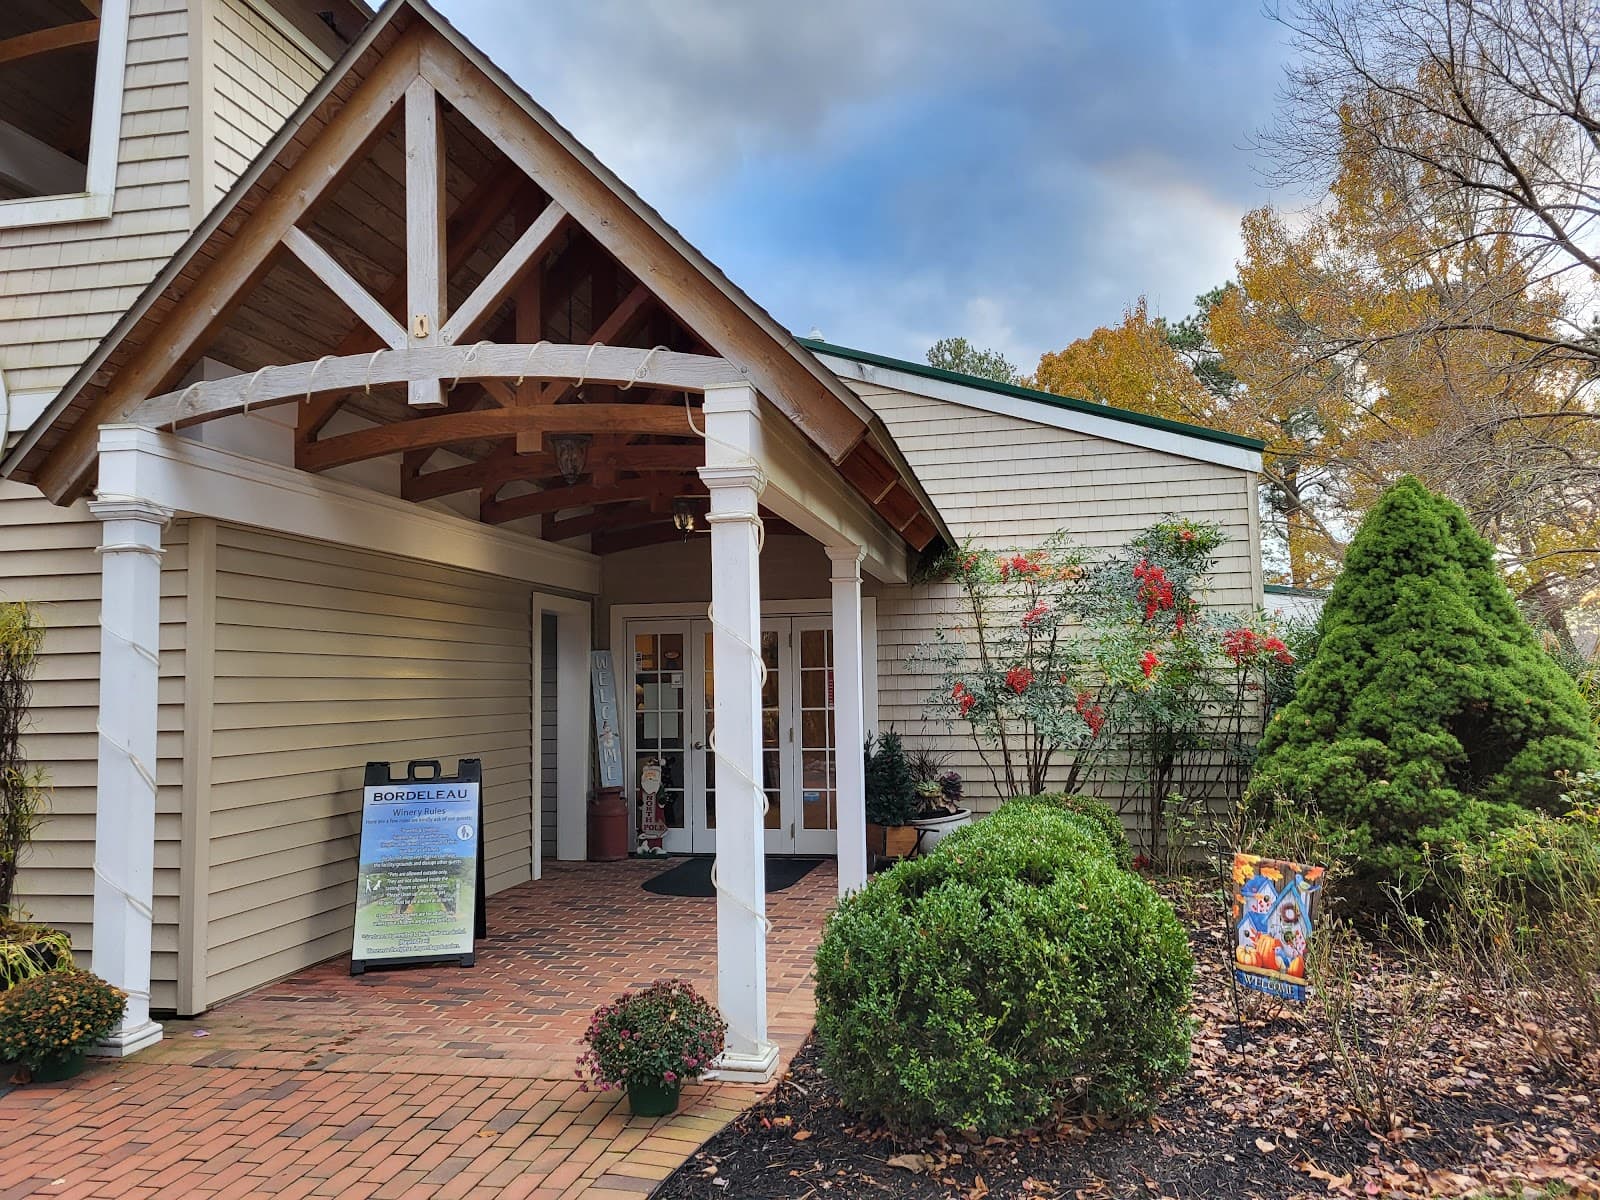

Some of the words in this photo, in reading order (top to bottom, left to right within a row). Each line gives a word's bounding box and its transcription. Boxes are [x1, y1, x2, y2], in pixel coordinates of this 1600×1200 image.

[373, 789, 468, 802] BORDELEAU
[393, 809, 422, 819] Winery
[424, 808, 446, 816] Rules
[1244, 973, 1294, 994] WELCOME
